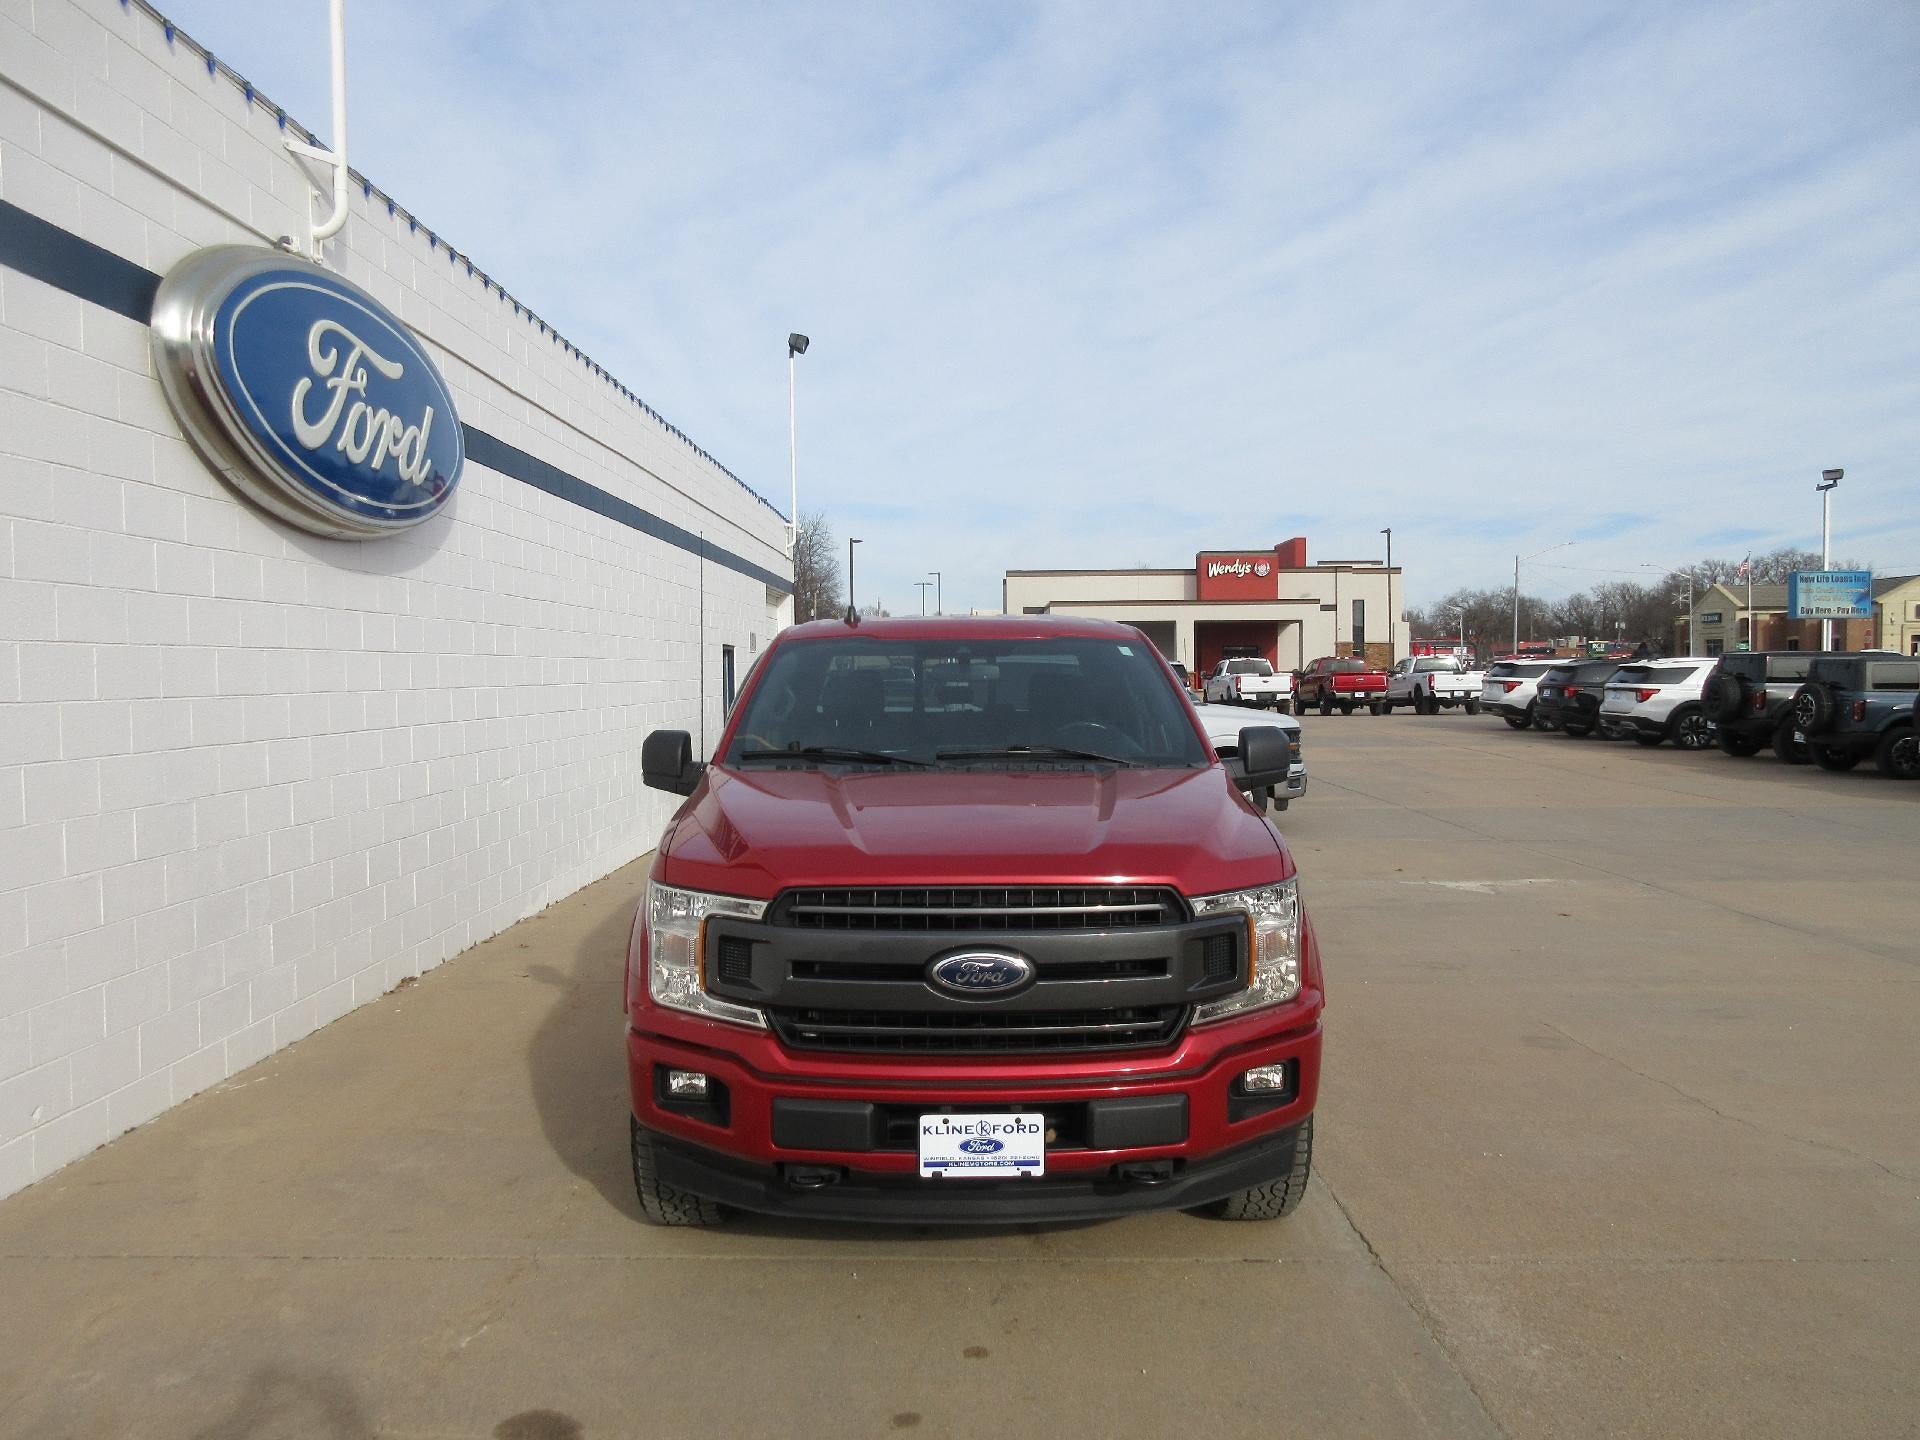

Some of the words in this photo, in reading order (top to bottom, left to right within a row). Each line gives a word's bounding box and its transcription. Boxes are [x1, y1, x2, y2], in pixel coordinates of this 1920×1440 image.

[291, 318, 434, 487] Ford
[1208, 559, 1252, 578] Wendy's
[1799, 575, 1815, 583] New
[1816, 575, 1830, 583] Life
[1831, 575, 1854, 583] Loans
[1800, 607, 1814, 615] Buy
[1837, 607, 1850, 615] Pay
[956, 961, 1008, 984] Ford
[923, 1124, 974, 1136] KLINE
[992, 1123, 1040, 1134] FORD
[967, 1139, 996, 1152] Ford
